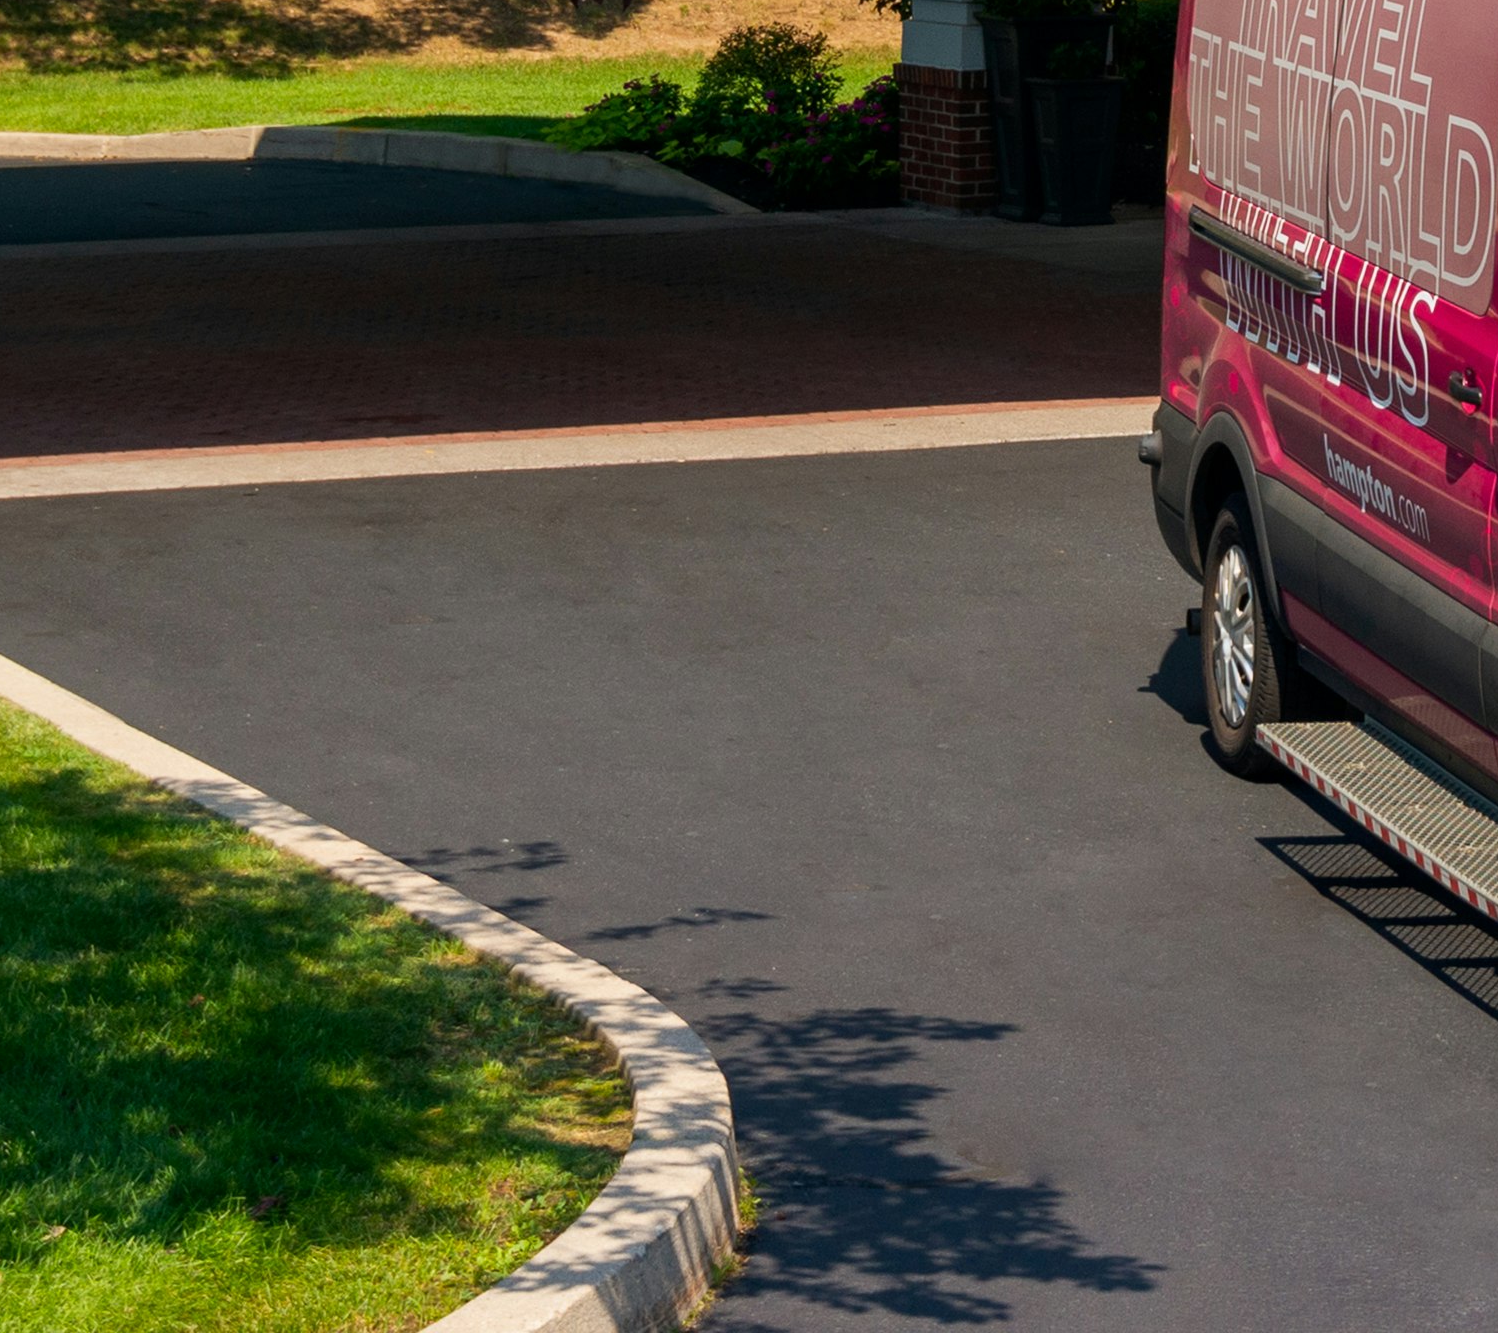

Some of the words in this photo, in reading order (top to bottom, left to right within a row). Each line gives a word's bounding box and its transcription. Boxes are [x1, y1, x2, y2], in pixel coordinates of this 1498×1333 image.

[1188, 27, 1265, 201] THE
[1276, 61, 1496, 287] WORLD
[1354, 238, 1440, 427] US
[1323, 433, 1431, 543] hampton.com
